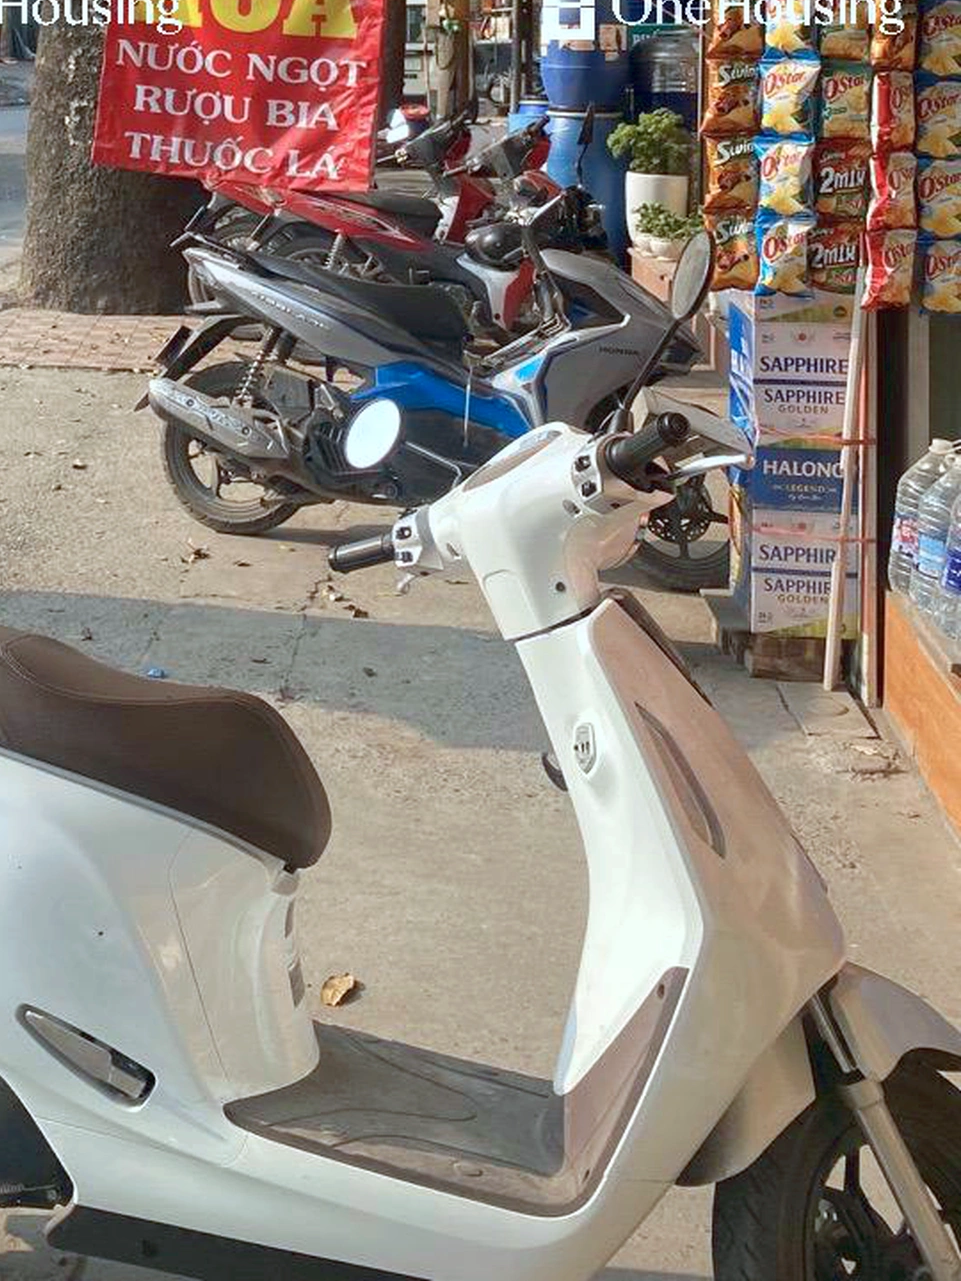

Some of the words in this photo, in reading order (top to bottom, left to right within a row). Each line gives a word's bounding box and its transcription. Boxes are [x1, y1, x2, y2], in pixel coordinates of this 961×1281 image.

[116, 39, 233, 78] NƯỚC
[246, 53, 367, 92] NGỌT
[134, 84, 251, 125] RƯỢU
[266, 99, 339, 130] BIA
[124, 131, 274, 175] THUỐC
[285, 144, 344, 180] LÁ
[598, 346, 640, 356] HONDA
[759, 355, 849, 375] SAPPHIRE
[764, 388, 845, 406] SAPPHIRE
[778, 404, 829, 415] GOLDEN
[759, 544, 837, 564] SAPPHIR
[764, 577, 832, 595] SAPPHIR
